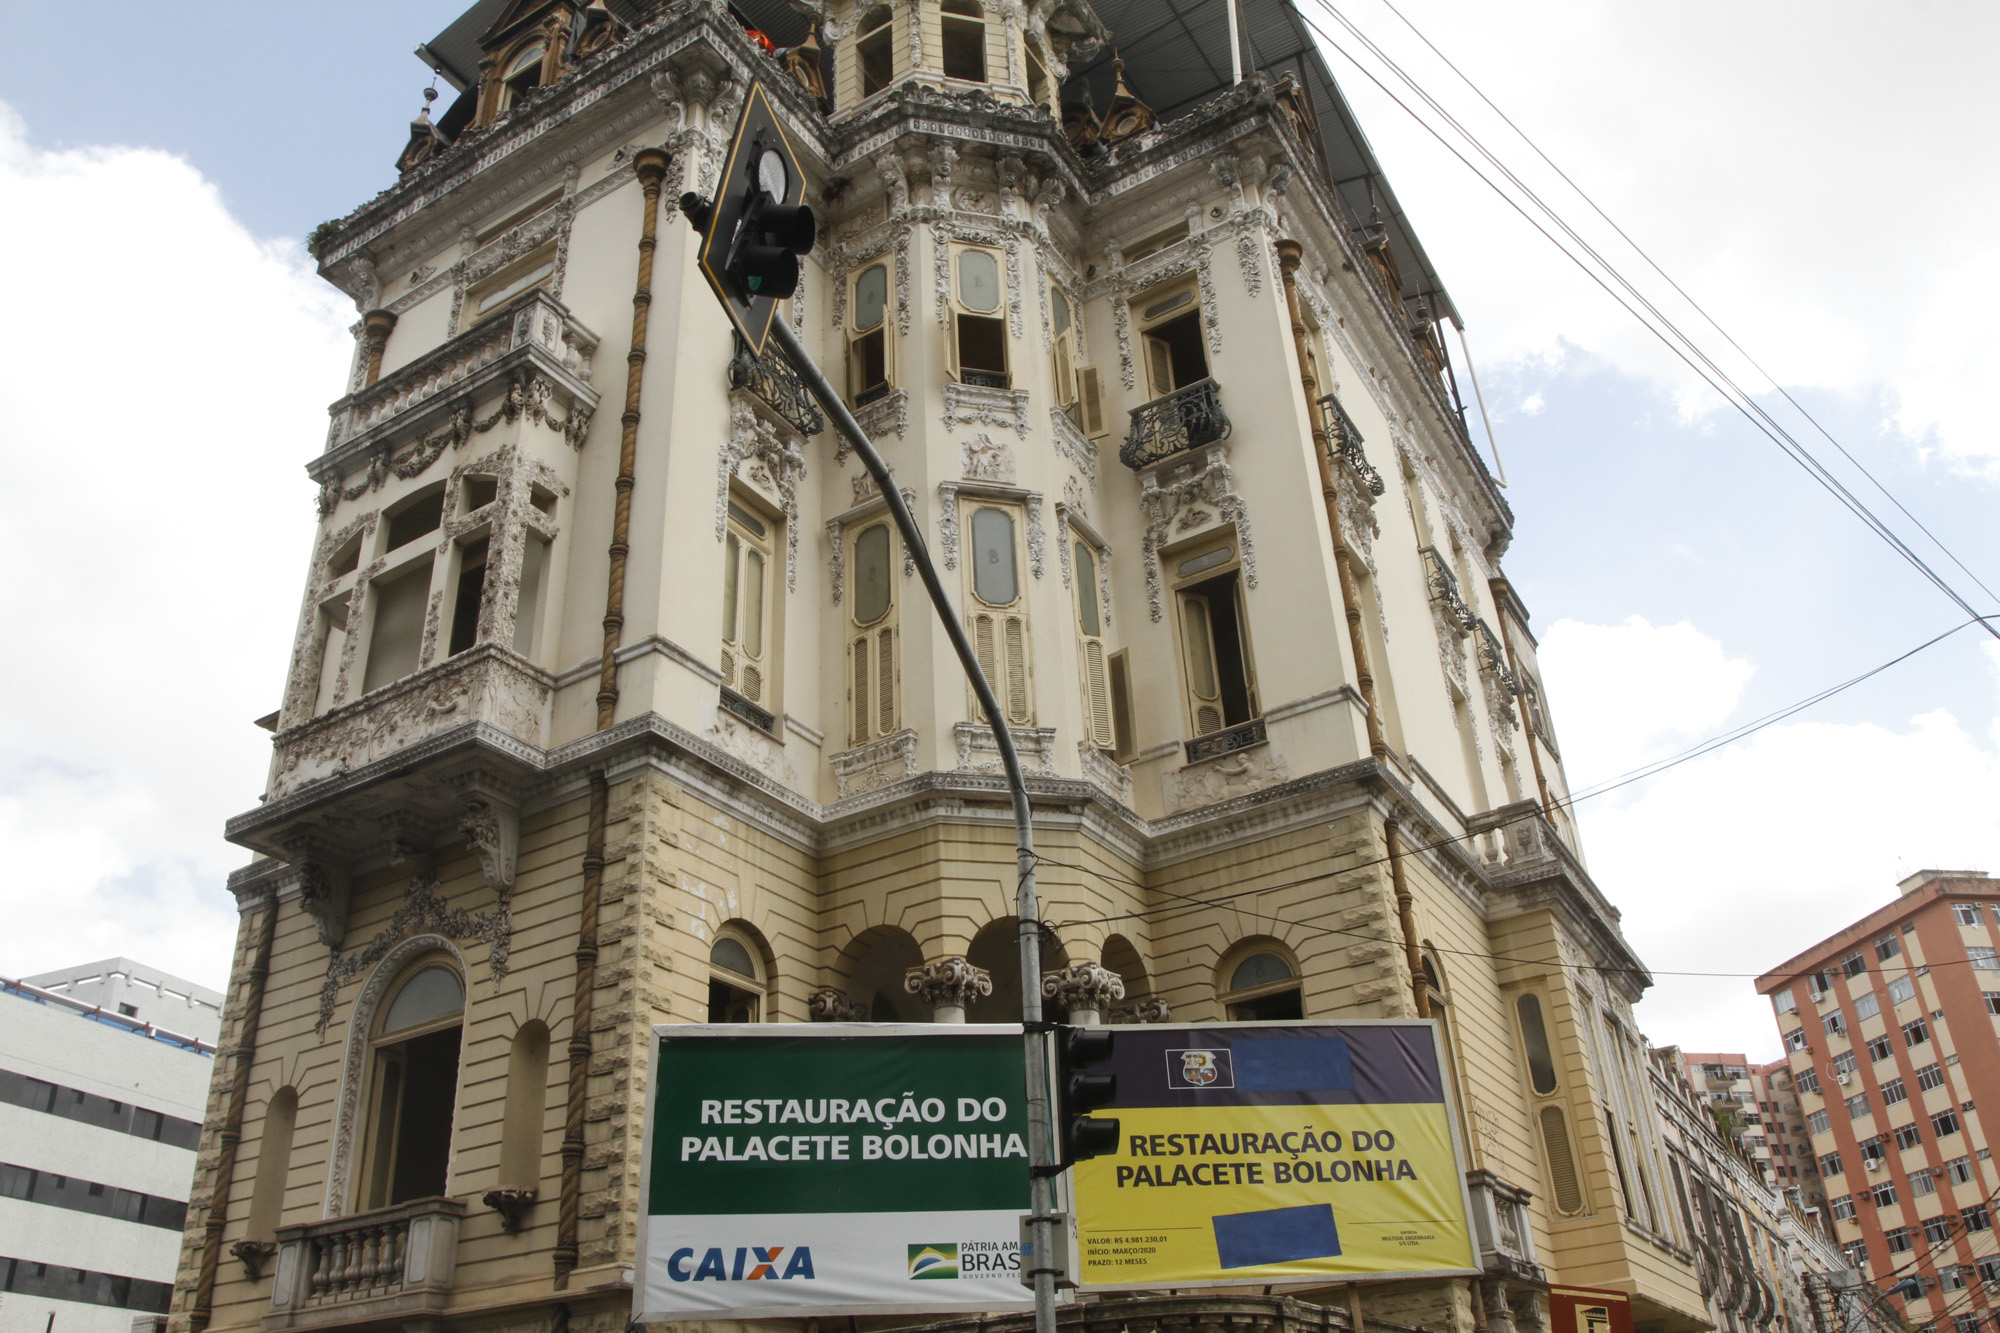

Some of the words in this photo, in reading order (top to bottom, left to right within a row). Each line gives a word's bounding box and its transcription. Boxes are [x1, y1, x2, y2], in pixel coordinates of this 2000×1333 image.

[700, 1091, 946, 1130] RESTAURAÇÃO
[957, 1097, 1007, 1123] DO
[681, 1135, 850, 1162] PALACETE
[862, 1133, 1028, 1161] BOLONHA
[1129, 1125, 1342, 1160] RESTAURAÇÃO
[1352, 1129, 1395, 1152] DO
[1116, 1161, 1264, 1188] PALACETE
[1274, 1158, 1418, 1184] BOLONHA
[961, 1240, 999, 1252] PÁTRIA
[1001, 1241, 1021, 1251] AM
[1112, 1247, 1156, 1255] MARÇO/2020
[667, 1246, 815, 1282] CAIXA
[962, 1252, 1020, 1271] BRAS
